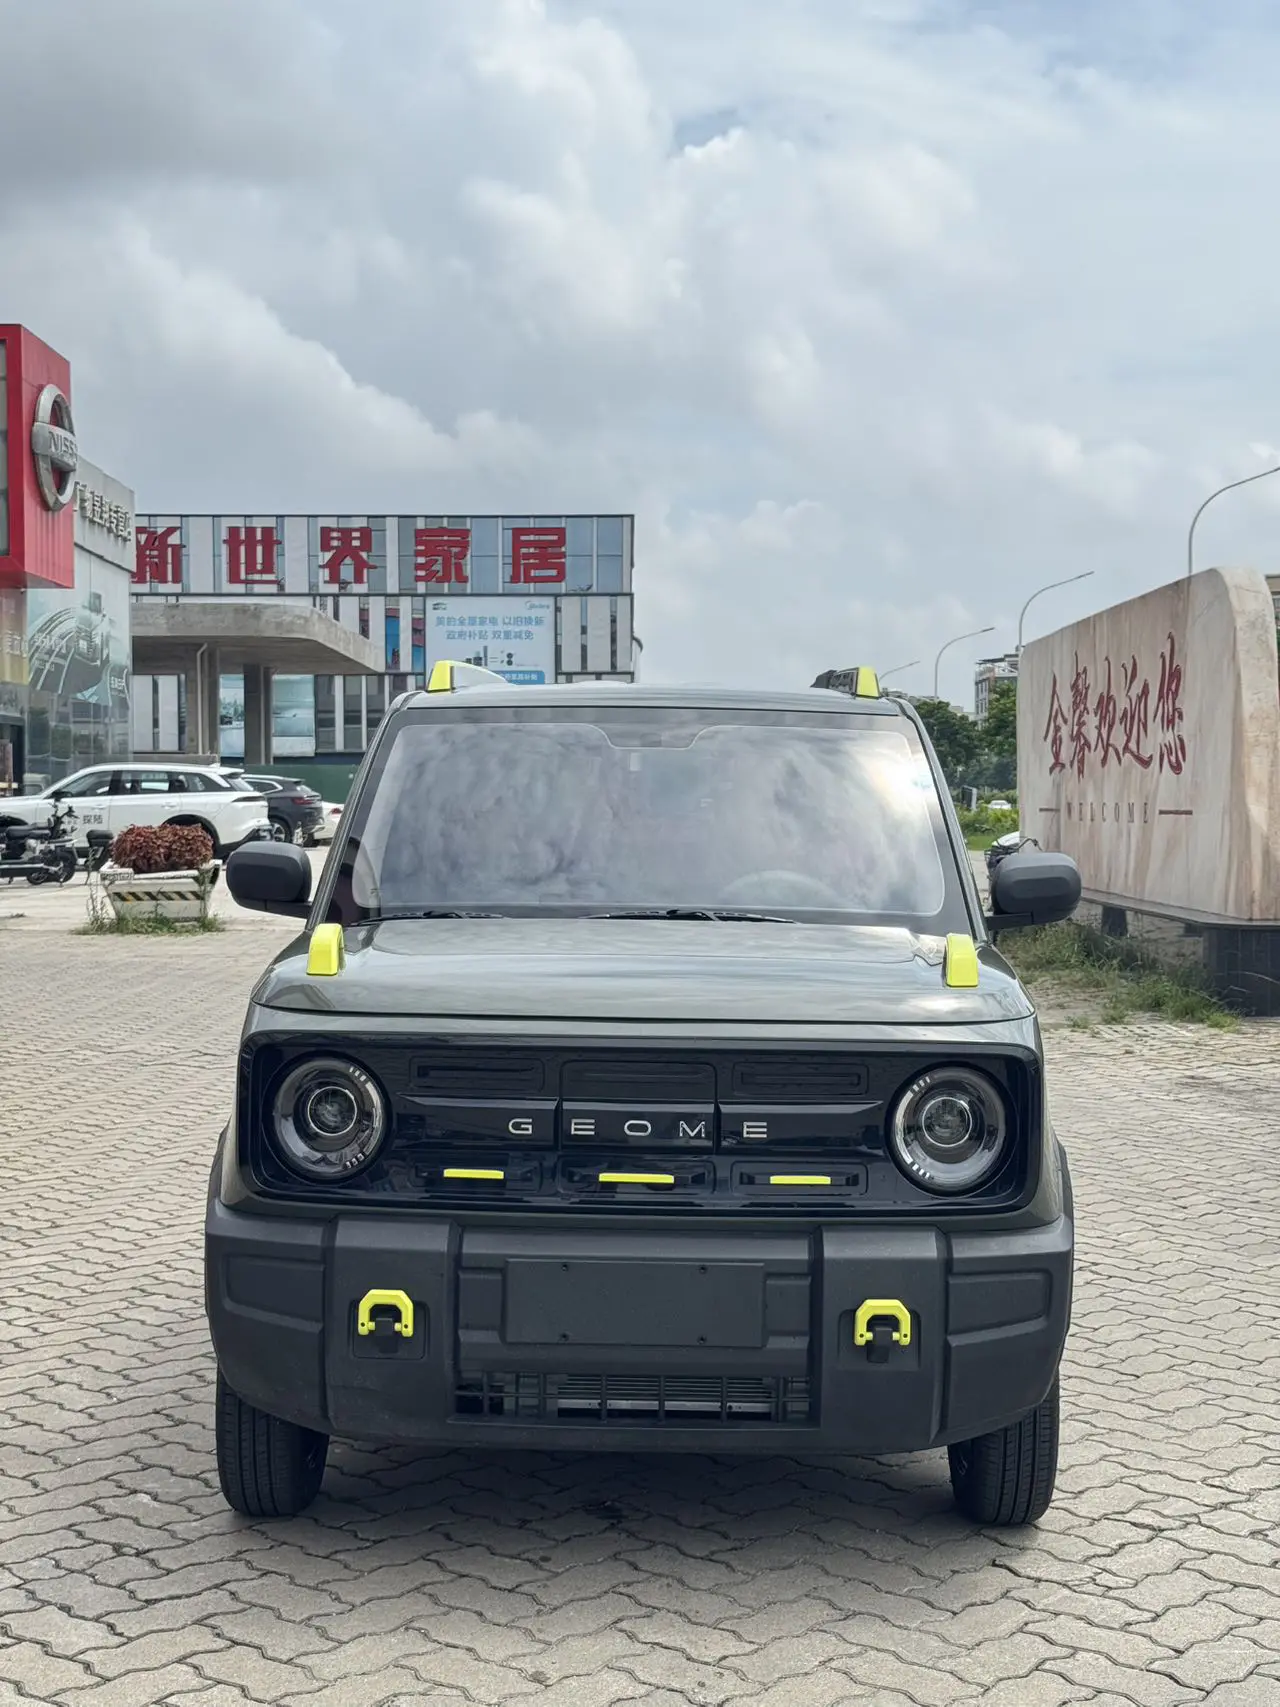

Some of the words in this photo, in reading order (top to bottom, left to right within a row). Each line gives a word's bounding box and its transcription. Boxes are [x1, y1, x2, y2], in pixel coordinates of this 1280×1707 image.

[131, 525, 567, 584] 新世界家居
[1066, 800, 1149, 825] WELCOME
[507, 1117, 769, 1140] GEOME
